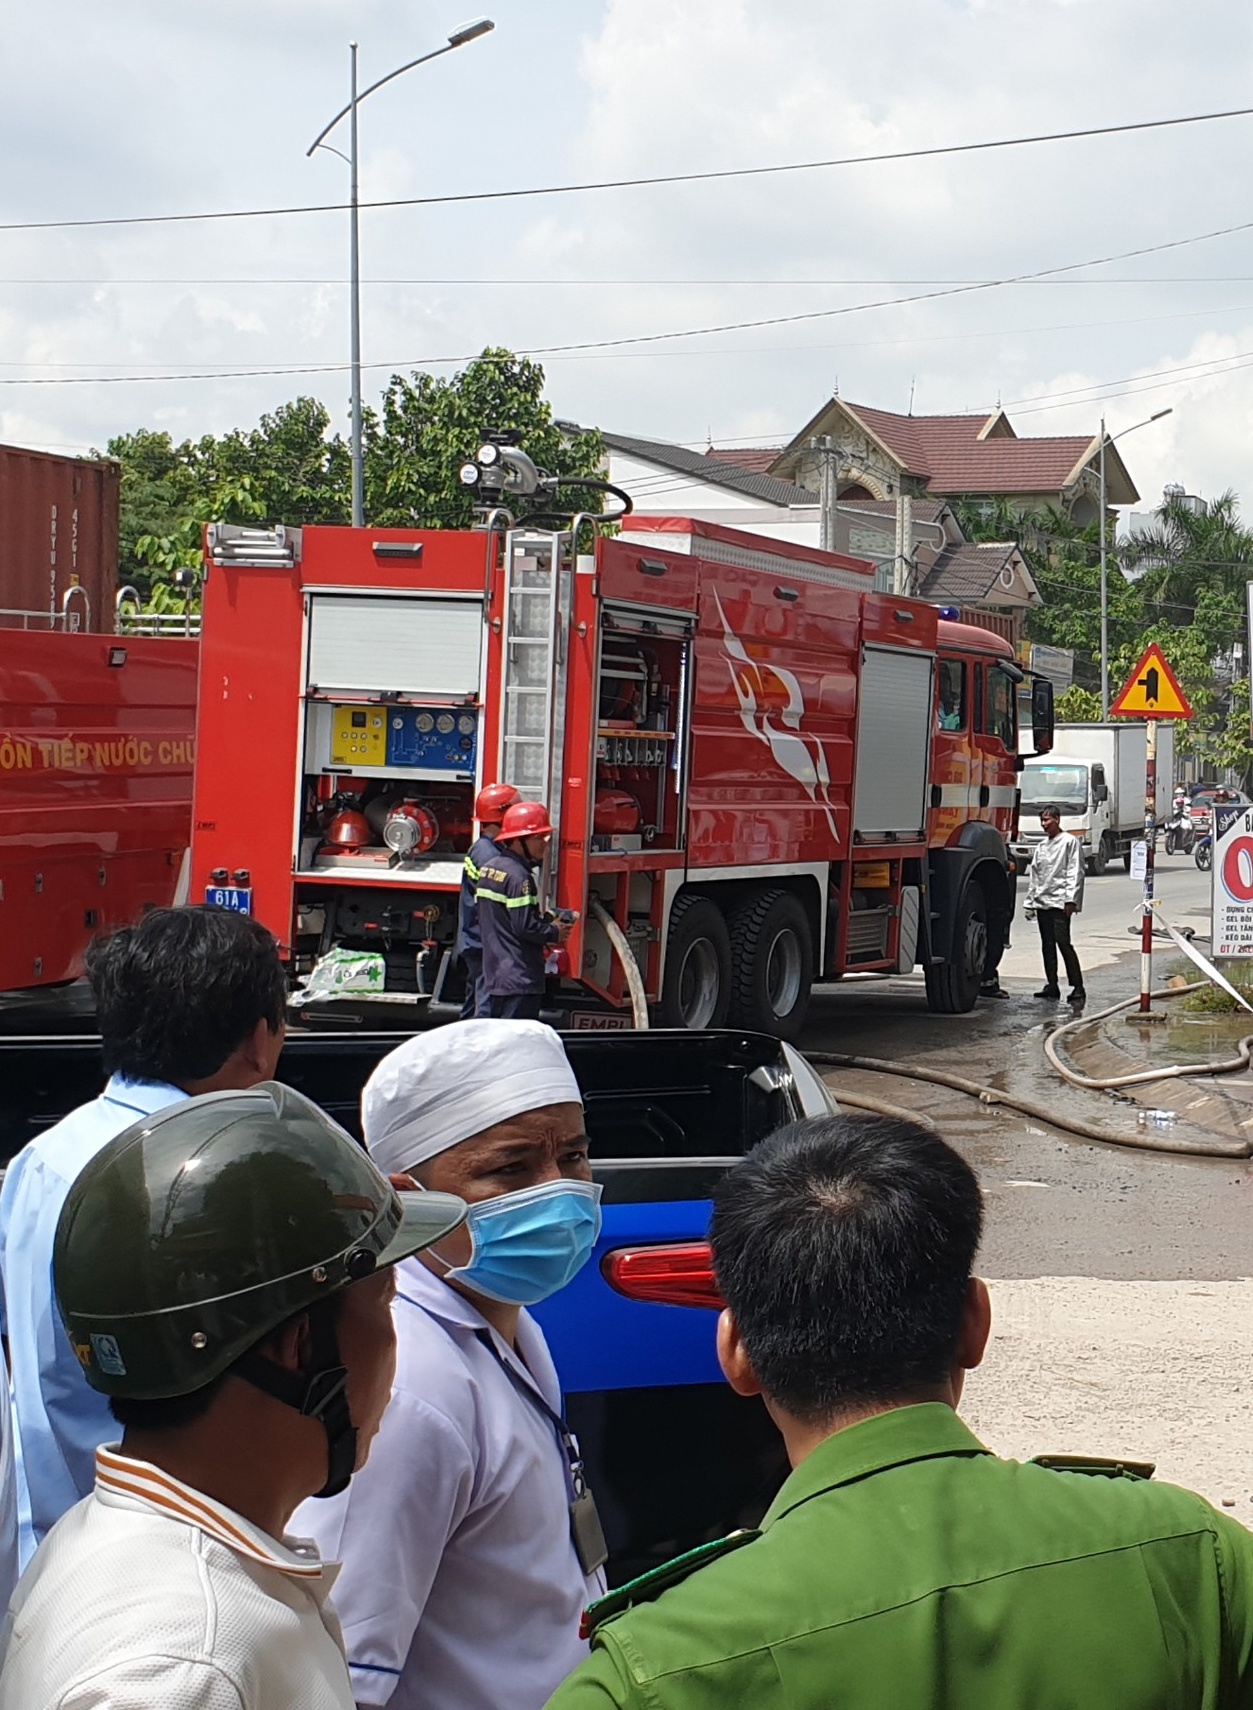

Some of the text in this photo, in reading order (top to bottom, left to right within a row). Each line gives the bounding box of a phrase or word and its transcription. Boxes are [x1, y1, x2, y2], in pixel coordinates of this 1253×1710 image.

[38, 732, 90, 768] TIẾP
[95, 735, 152, 766] NƯỚC
[1218, 809, 1239, 831] Shop
[215, 890, 239, 906] 61A
